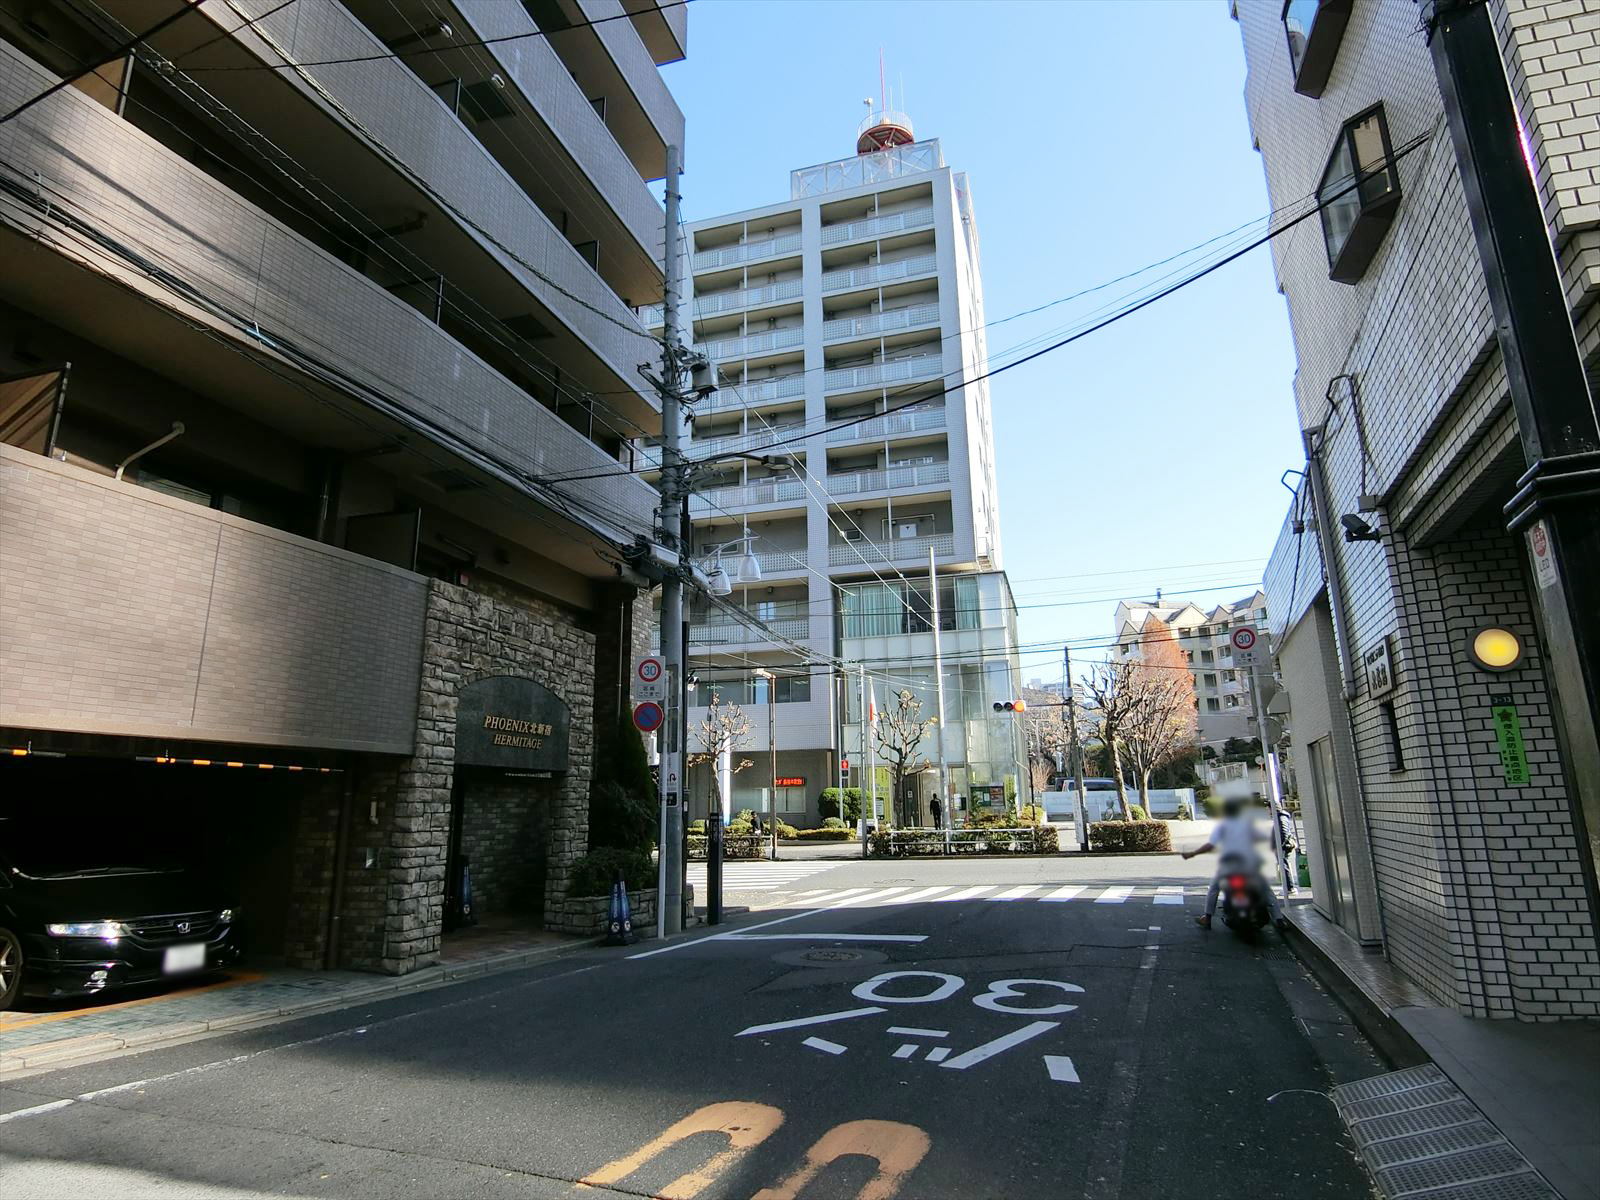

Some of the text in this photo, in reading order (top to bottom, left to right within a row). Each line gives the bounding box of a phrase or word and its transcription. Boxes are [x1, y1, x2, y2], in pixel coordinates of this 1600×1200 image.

[1238, 634, 1251, 644] 30
[643, 665, 657, 676] 30
[494, 733, 543, 749] HERMITAGE
[851, 970, 1086, 1015] 30
